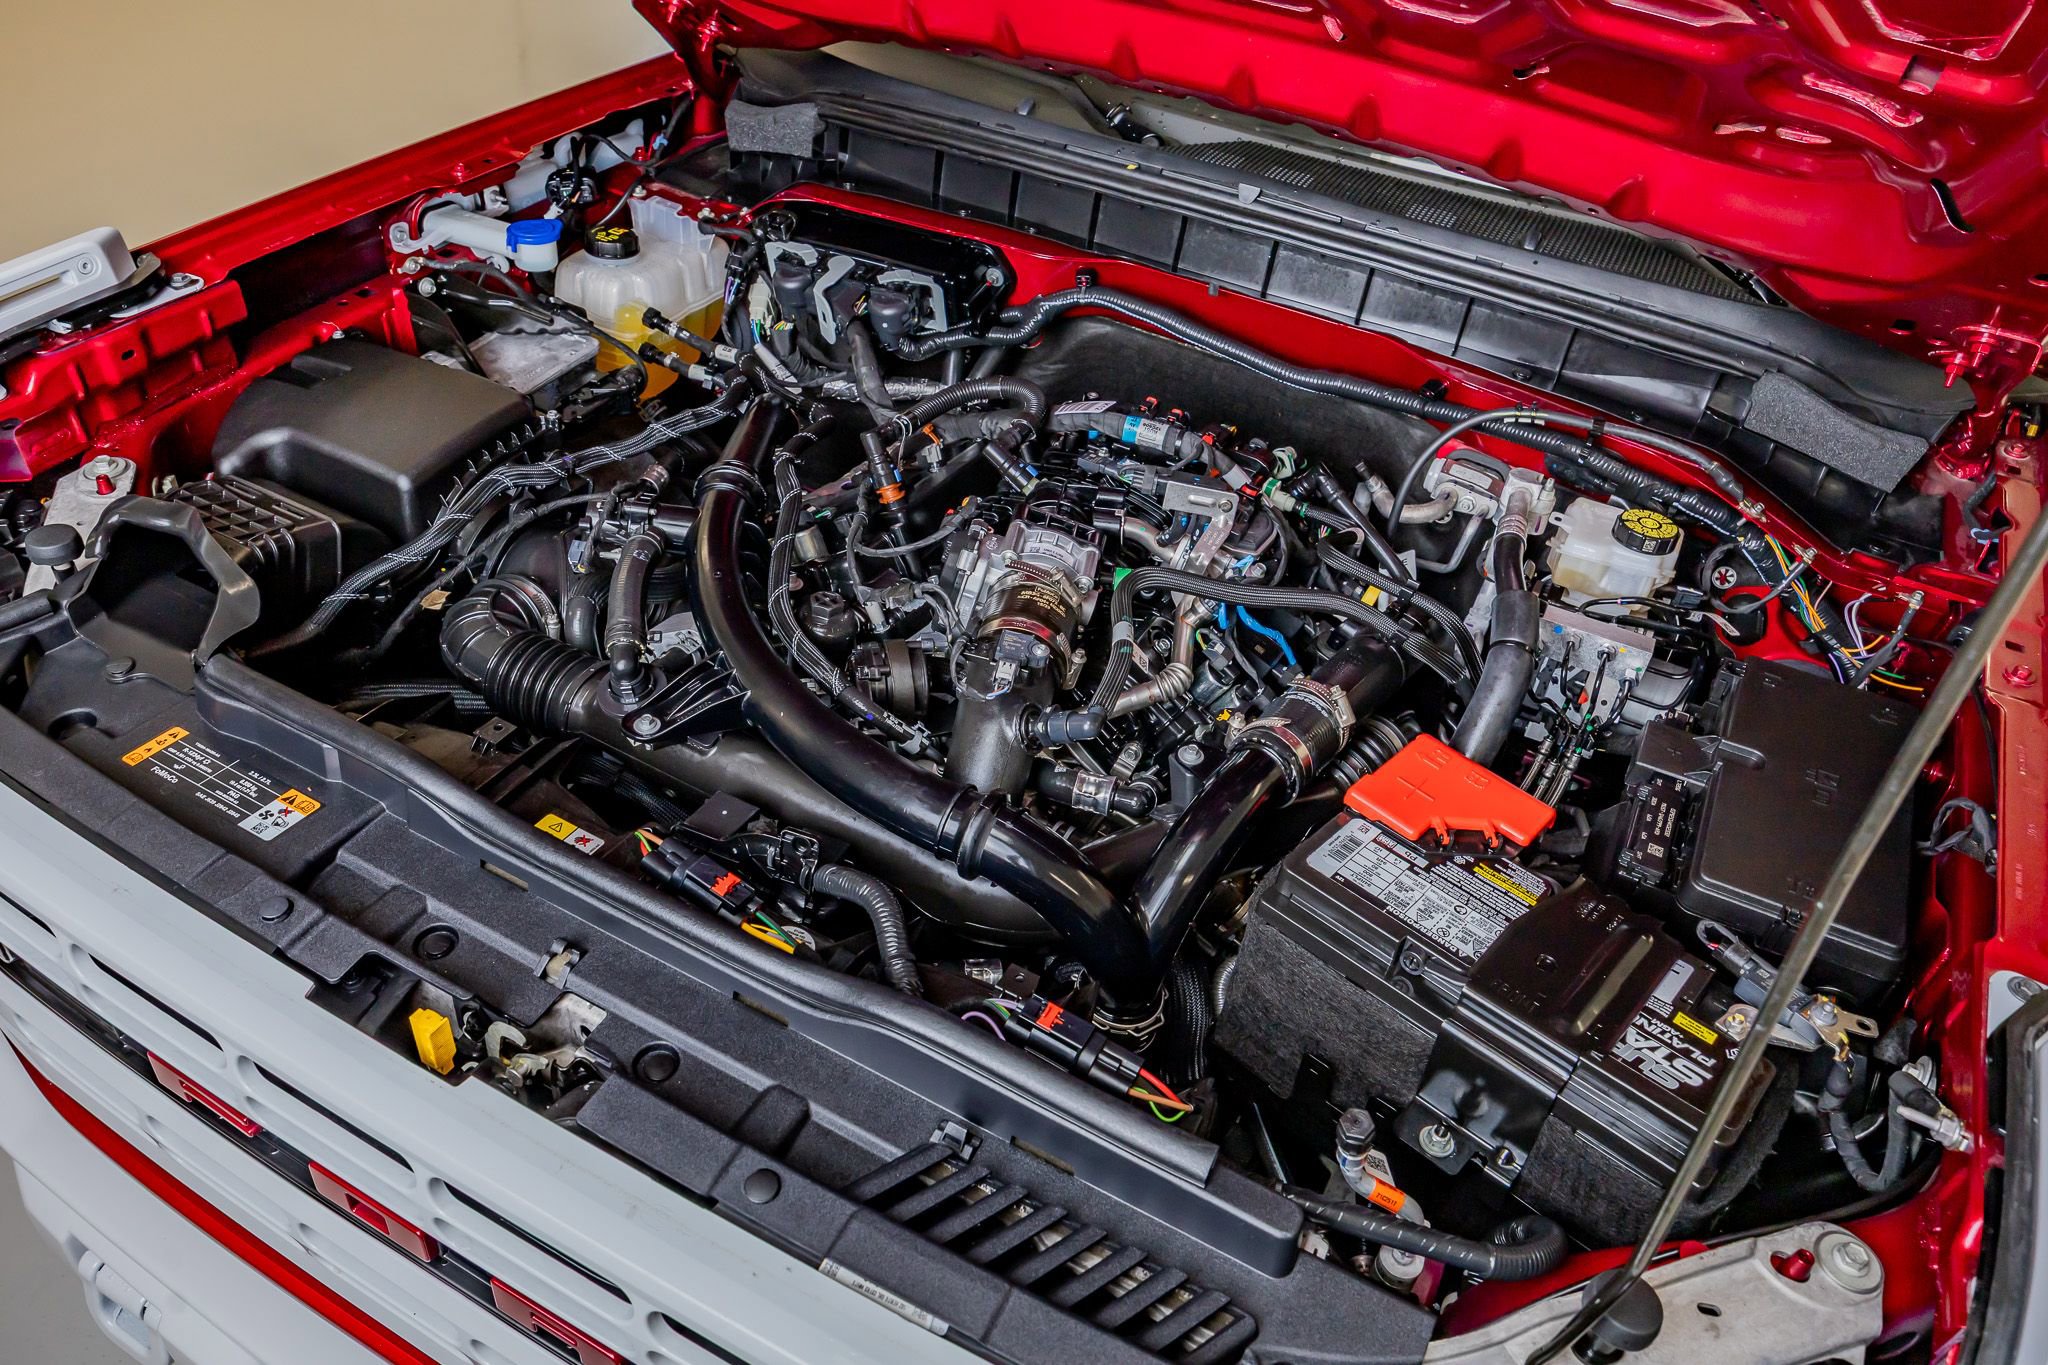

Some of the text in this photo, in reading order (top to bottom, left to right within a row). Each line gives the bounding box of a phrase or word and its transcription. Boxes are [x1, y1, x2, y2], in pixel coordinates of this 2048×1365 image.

[149, 765, 180, 784] FoMoCo
[1402, 850, 1418, 861] Pb
[1334, 874, 1345, 882] 12V
[1385, 904, 1458, 952] DANGER/POISON
[1633, 1015, 1716, 1067] PLATIN
